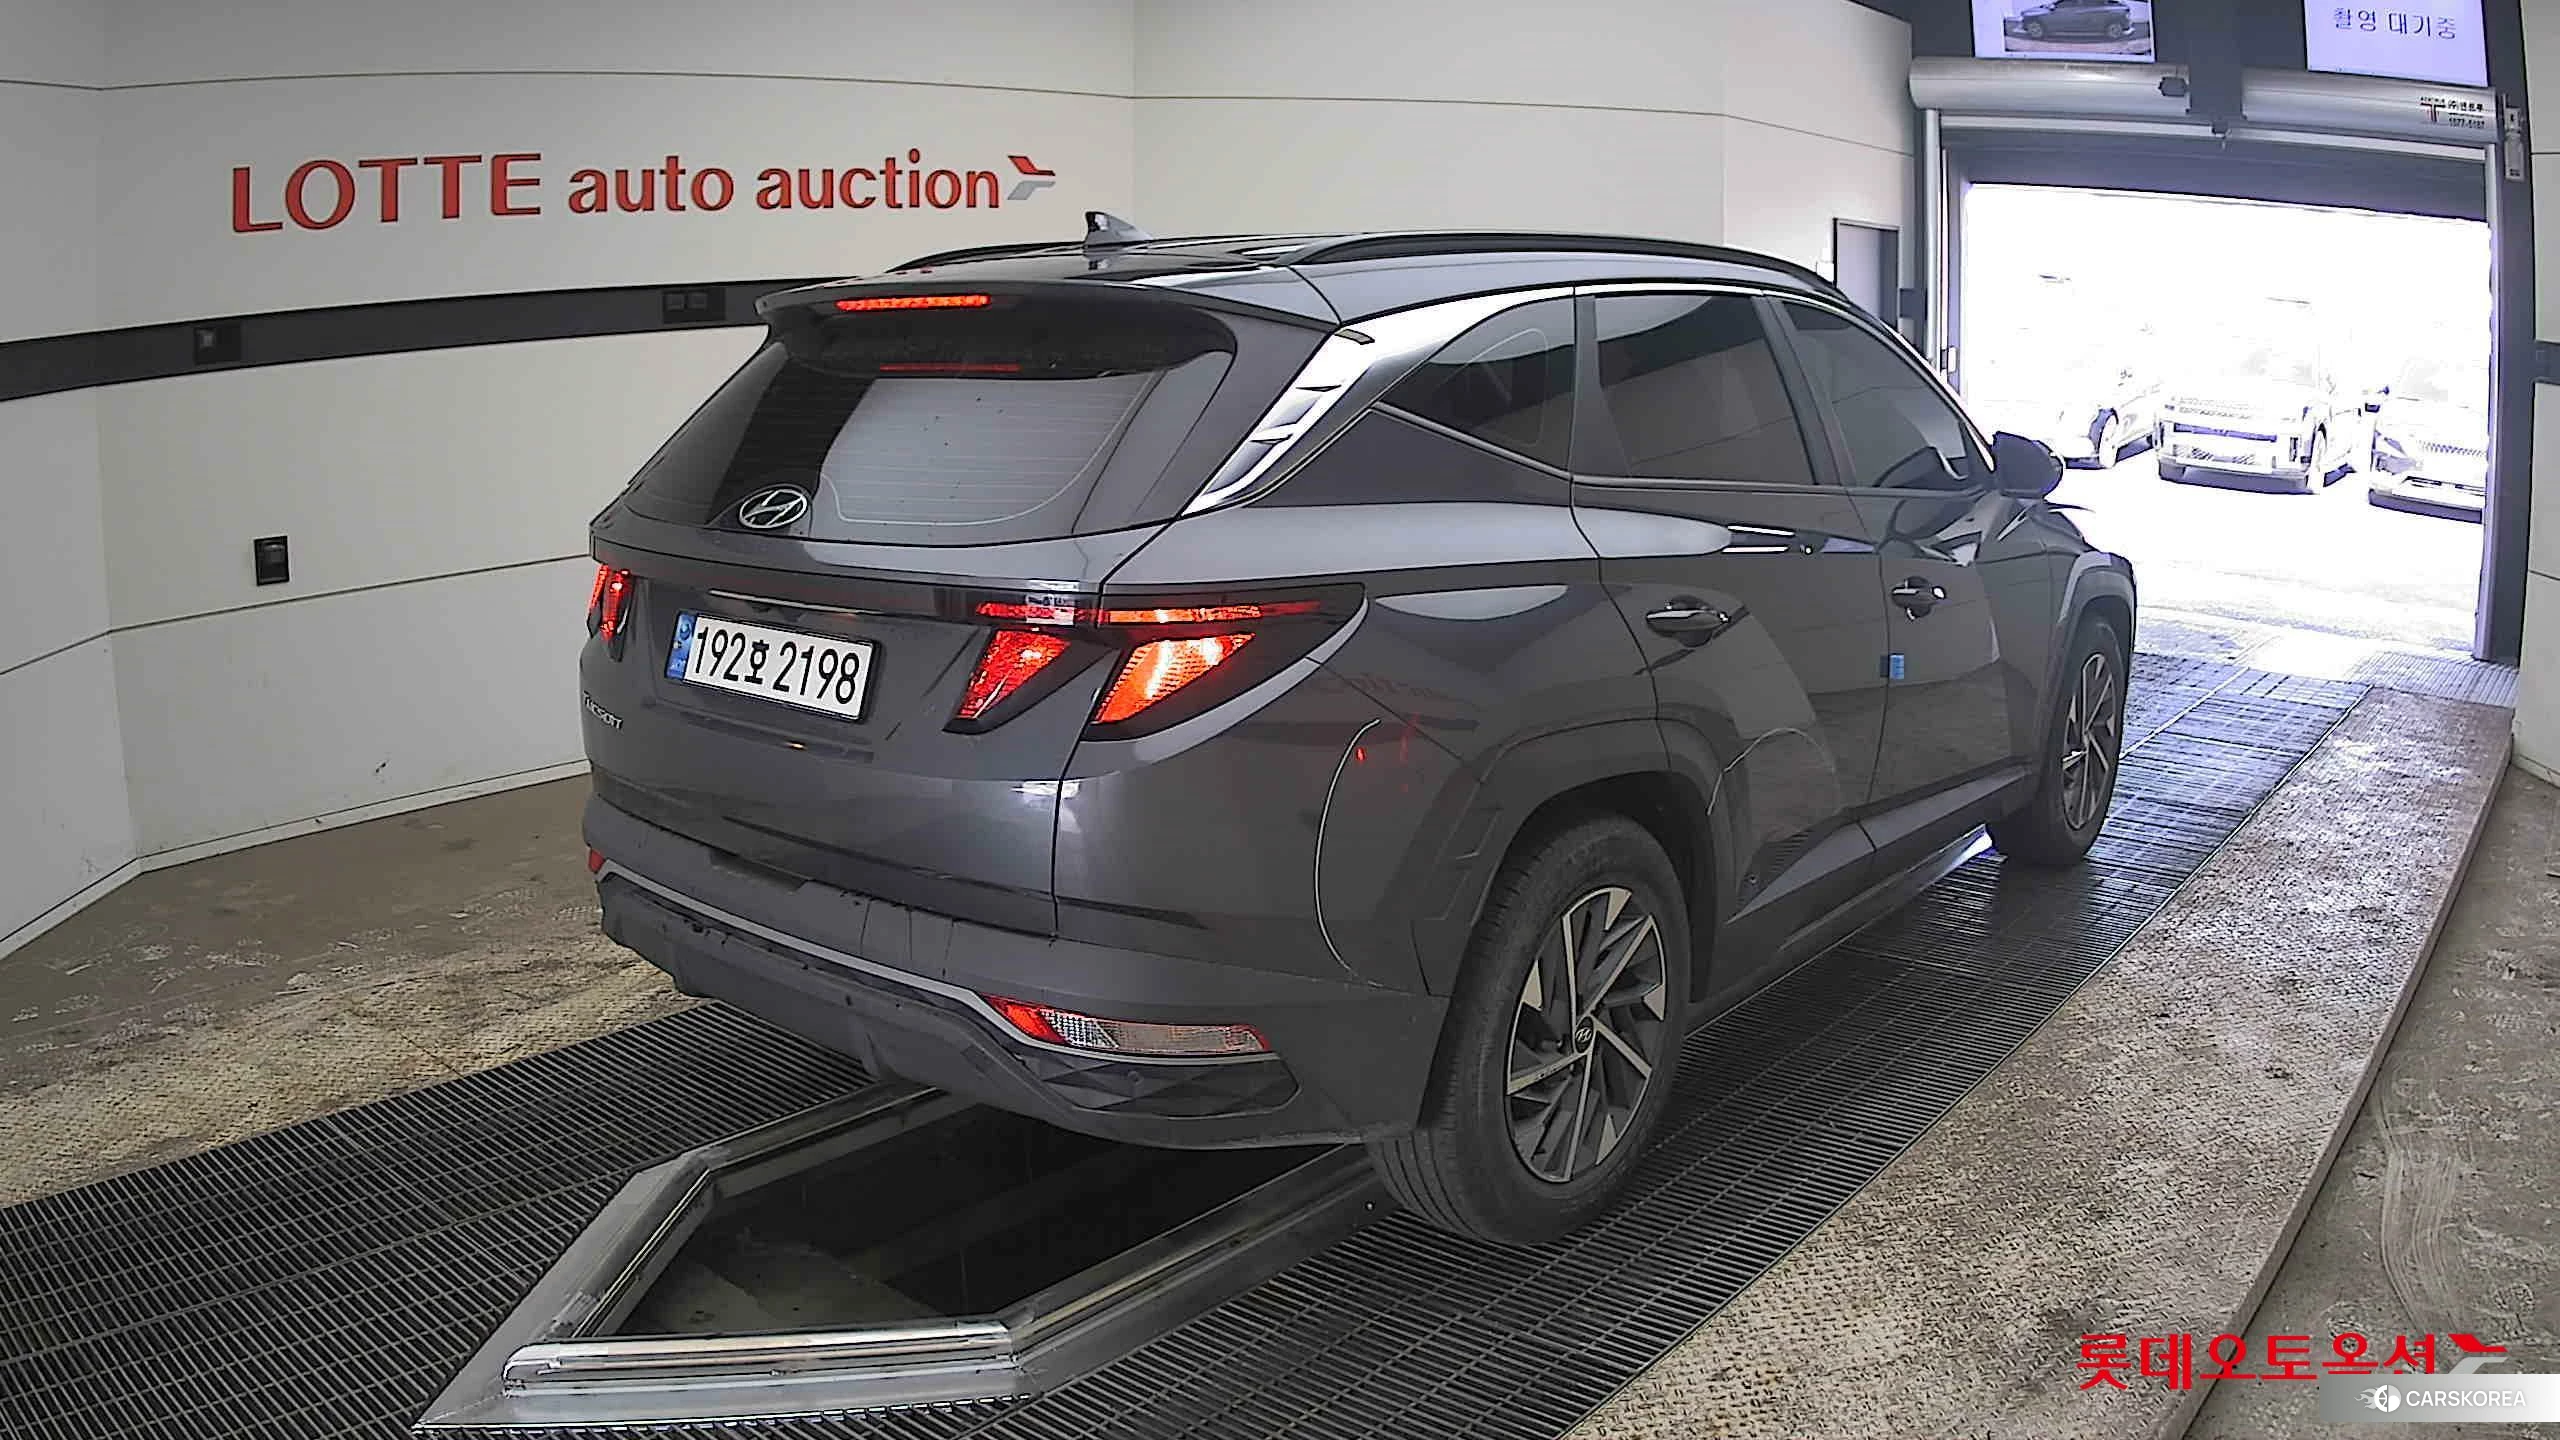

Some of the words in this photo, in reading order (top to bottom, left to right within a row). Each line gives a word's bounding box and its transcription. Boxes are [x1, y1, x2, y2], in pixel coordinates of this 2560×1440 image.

[2387, 11, 2457, 40] 대기중
[232, 152, 542, 233] LOTTE
[568, 155, 735, 214] auto
[756, 148, 1001, 210] auction
[695, 625, 770, 686] 192호
[773, 641, 860, 705] 2198
